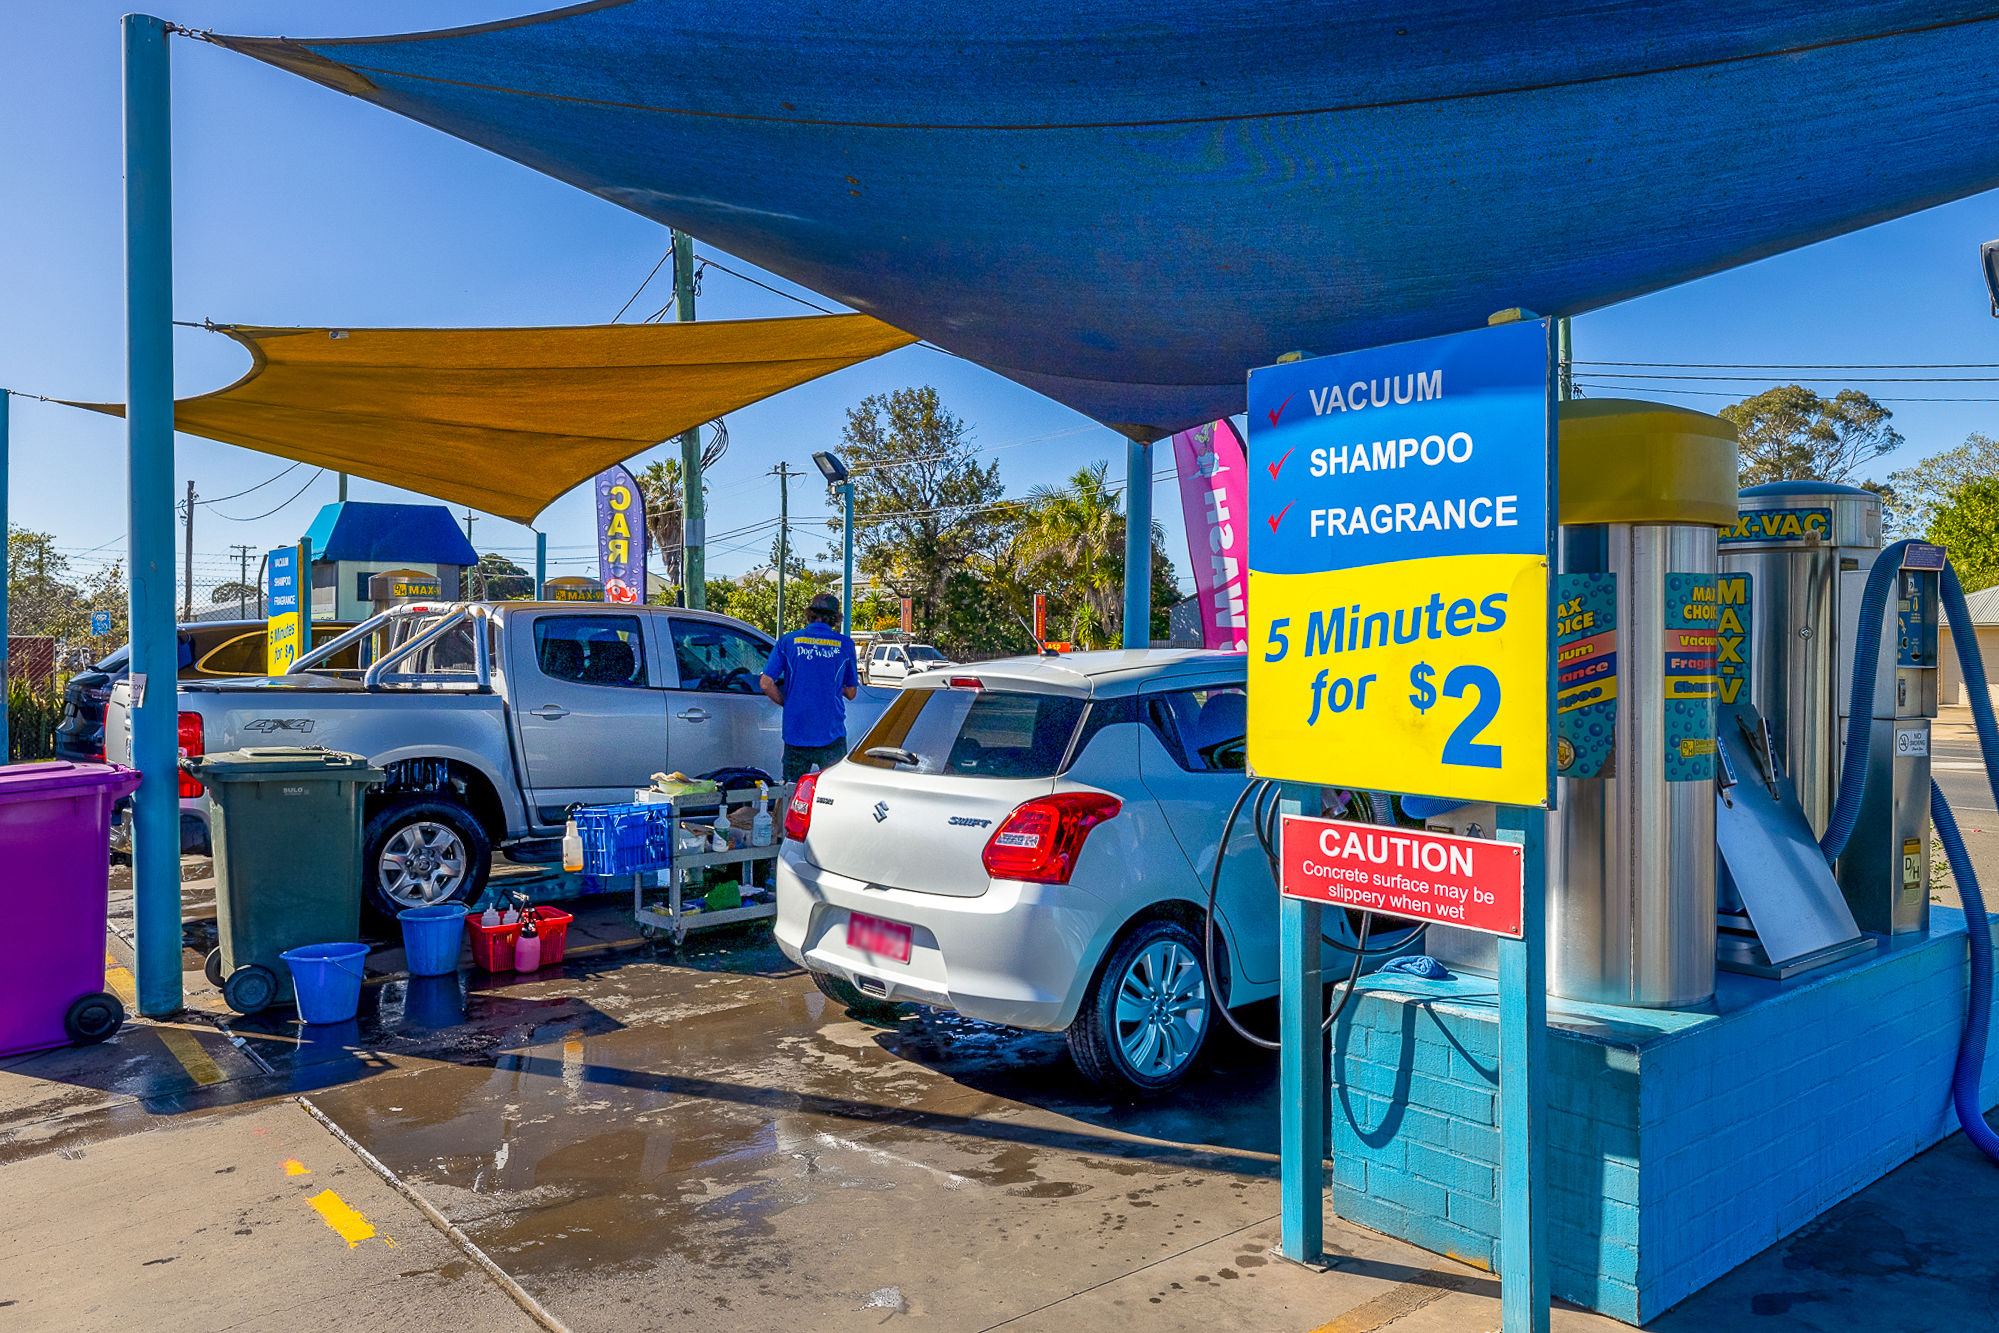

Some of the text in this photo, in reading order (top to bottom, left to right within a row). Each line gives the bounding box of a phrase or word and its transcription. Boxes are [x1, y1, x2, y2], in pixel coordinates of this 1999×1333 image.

[1309, 370, 1443, 416] VACUUM
[1309, 432, 1473, 477] SHAMPOO
[1310, 495, 1518, 538] FRAGRANCE
[1264, 592, 1508, 663] 5 Minutes
[797, 646, 814, 660] Dog
[1307, 661, 1503, 769] for $2
[948, 816, 992, 829] SWIFT
[1319, 829, 1473, 877] CAUTION
[1302, 860, 1495, 905] Concrete surface may be
[1328, 884, 1465, 919] slippery when wet
